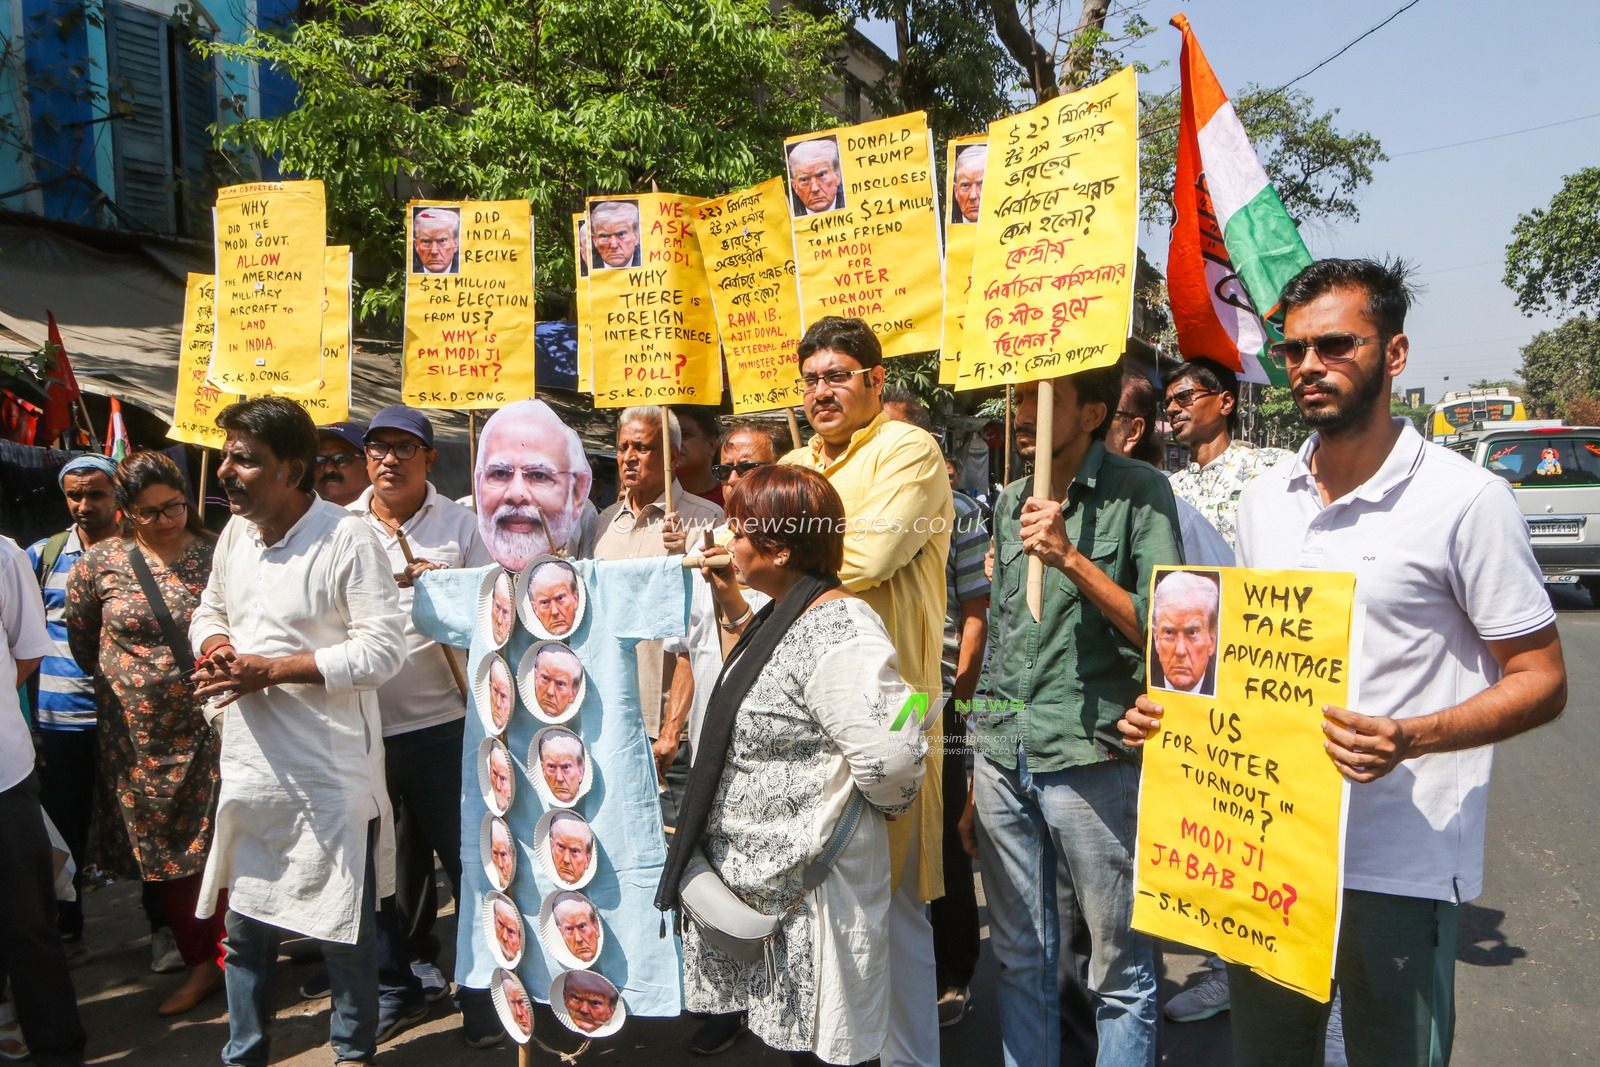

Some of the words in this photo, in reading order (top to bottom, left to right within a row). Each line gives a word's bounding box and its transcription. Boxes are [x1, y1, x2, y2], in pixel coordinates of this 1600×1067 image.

[847, 128, 911, 152] DONALD
[855, 146, 914, 168] TRUMP
[851, 170, 927, 194] DISCLOSES
[241, 200, 269, 217] WHY
[659, 201, 684, 218] WE
[810, 211, 854, 233] GIVING
[860, 197, 896, 222] $21
[475, 211, 500, 224] DID
[228, 224, 241, 235] DID
[248, 219, 269, 231] THE
[466, 228, 511, 240] INDIA
[650, 220, 693, 239] ASK
[808, 238, 822, 247] TO
[827, 232, 847, 244] HIS
[853, 220, 903, 240] FRIEND
[224, 238, 247, 251] MODI
[255, 235, 290, 248] GOVT.
[814, 248, 833, 261] PM
[837, 242, 872, 258] MODI
[236, 252, 281, 269] ALLOW
[464, 249, 518, 263] RECIVE
[848, 257, 873, 269] FOR
[242, 270, 302, 283] AMERICAN
[454, 277, 506, 289] MILLION
[629, 269, 667, 287] WHY
[834, 267, 890, 287] VOTER
[231, 288, 282, 301] MILLITARY
[429, 294, 452, 304] FOR
[457, 291, 528, 309] ELECTION
[619, 290, 684, 309] THERE
[690, 297, 700, 307] IS
[819, 288, 884, 308] TURNOUT
[895, 286, 907, 296] IN
[230, 304, 277, 316] AIRCRAFT
[282, 306, 293, 314] TO
[424, 312, 455, 323] FROM
[607, 309, 684, 326] FOREIGN
[842, 302, 886, 319] INDIA.
[985, 307, 1004, 330] কি
[240, 319, 266, 331] LAND
[871, 318, 916, 334] CONG.
[442, 330, 477, 344] WHY
[485, 333, 497, 344] IS
[730, 329, 752, 342] AJIT
[228, 343, 238, 352] IN
[245, 336, 277, 353] INDIA.
[641, 343, 654, 351] IN
[733, 343, 778, 356] EXTERNAL
[780, 339, 801, 351] AFFA
[418, 348, 439, 359] PM
[445, 346, 479, 361] MODI
[485, 348, 500, 361] JI
[624, 351, 672, 364] INDIAN
[738, 357, 775, 371] MINISTER
[777, 353, 799, 366] JAB
[427, 362, 503, 383] SILENT?
[1529, 524, 1577, 533] B18TF4190
[1244, 581, 1313, 613] WHY
[1242, 613, 1314, 642] TAKE
[1223, 643, 1343, 684] ADVANTAGE
[1244, 677, 1314, 707] FROM
[1209, 707, 1242, 744] US
[1162, 730, 1198, 755] FOR
[1206, 743, 1280, 785] VOTER
[1181, 763, 1271, 809] TURNOUT
[1280, 800, 1294, 814] IN
[1181, 816, 1232, 855] MODI
[1241, 841, 1264, 872] JI
[1150, 842, 1236, 889] JABAB
[1251, 881, 1298, 926] DO?
